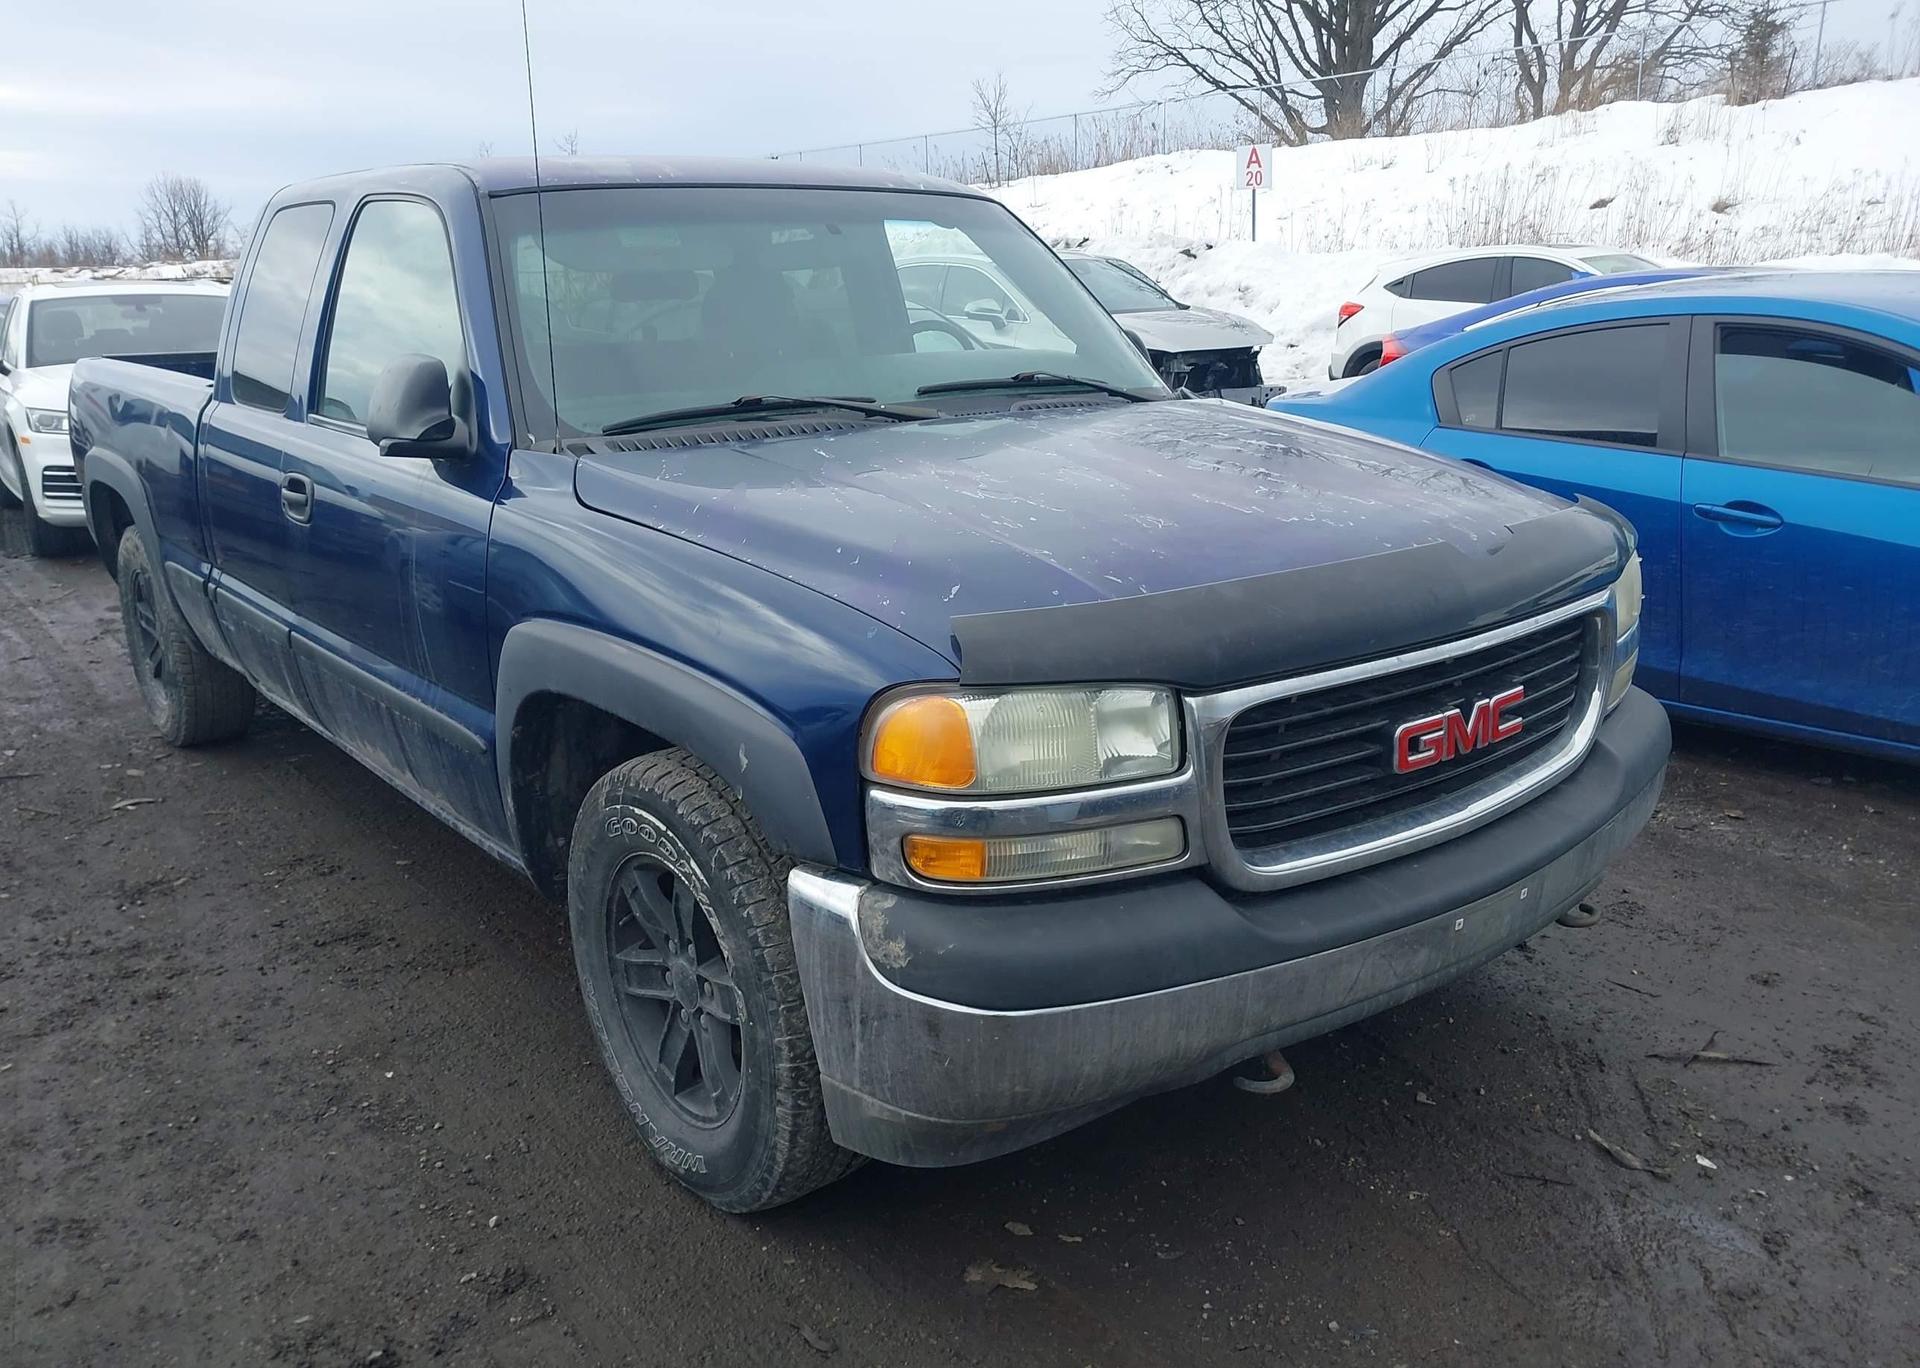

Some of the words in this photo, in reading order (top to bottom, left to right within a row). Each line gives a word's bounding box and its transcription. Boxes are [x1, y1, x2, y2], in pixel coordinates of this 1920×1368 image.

[1246, 145, 1262, 169] A
[1245, 170, 1263, 187] 20
[1393, 685, 1525, 774] GMC
